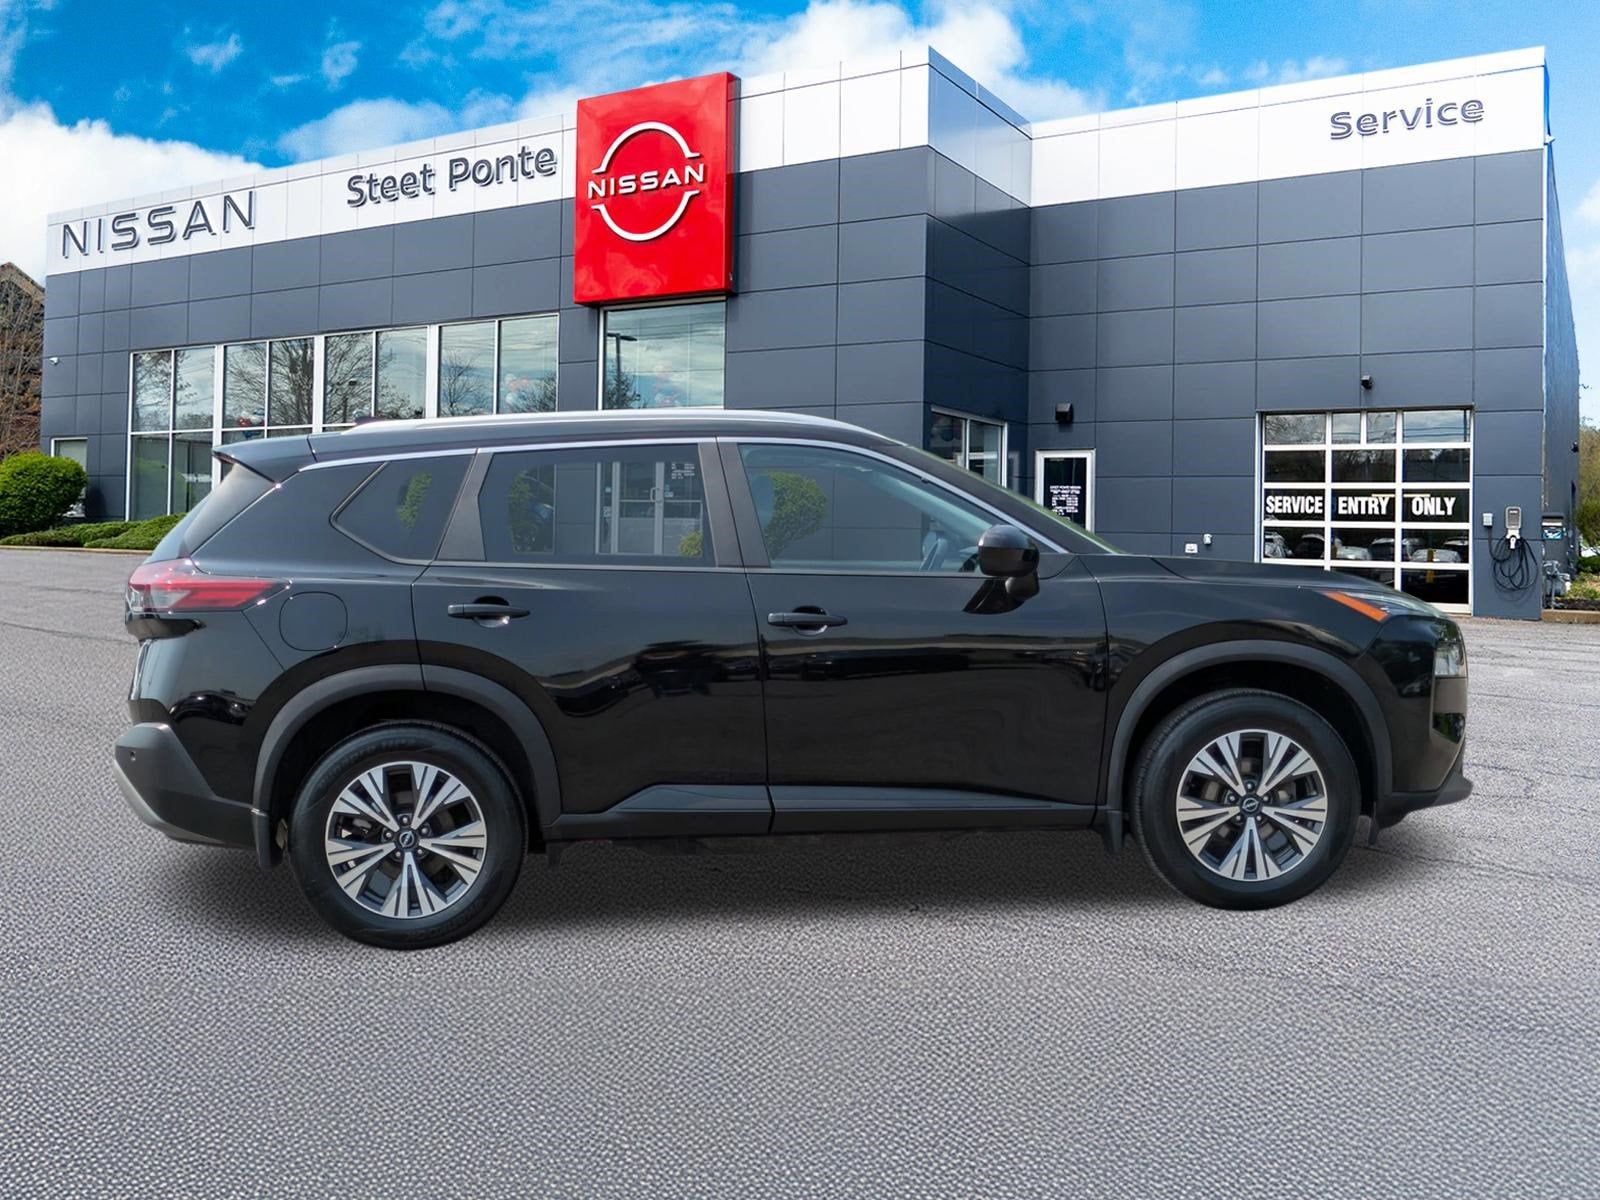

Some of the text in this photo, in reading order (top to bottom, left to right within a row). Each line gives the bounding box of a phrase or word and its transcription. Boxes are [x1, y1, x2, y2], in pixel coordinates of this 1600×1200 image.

[1330, 98, 1484, 140] Service
[347, 146, 557, 207] Steet Ponte
[587, 163, 704, 199] NISSAN
[62, 191, 254, 258] NISSAN
[1265, 495, 1457, 516] SERVICE ENTRY ONLY
